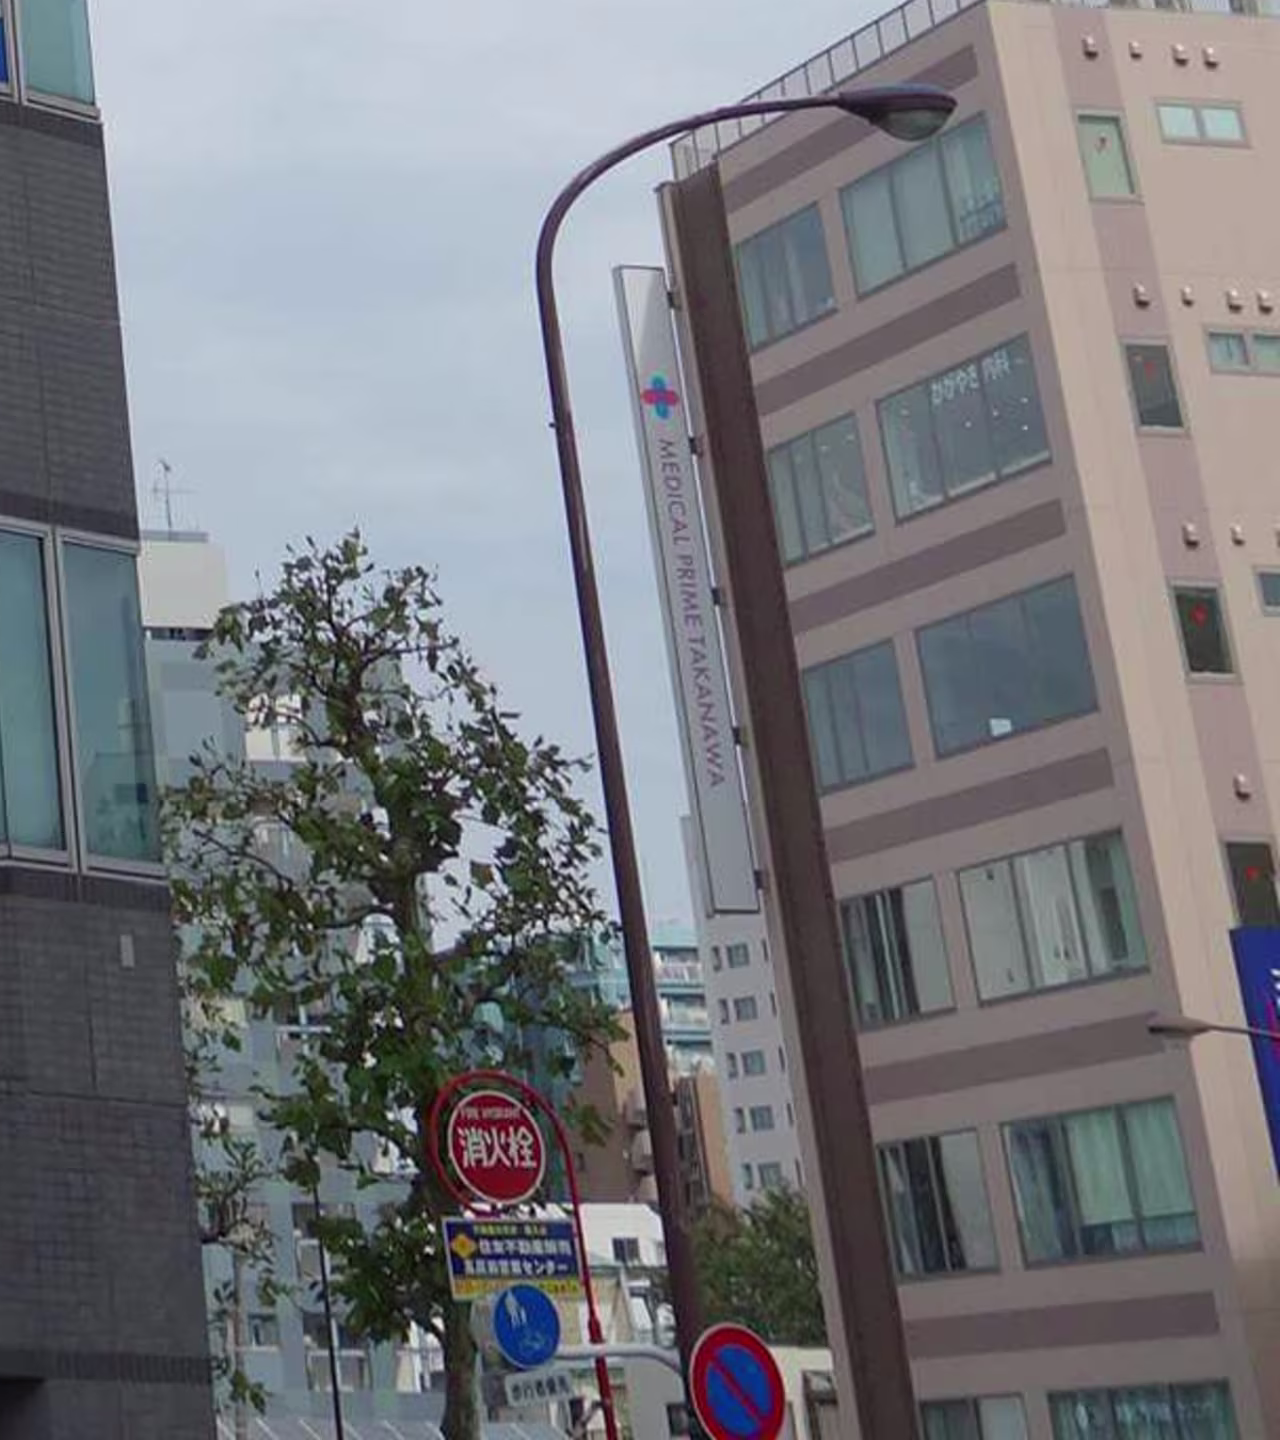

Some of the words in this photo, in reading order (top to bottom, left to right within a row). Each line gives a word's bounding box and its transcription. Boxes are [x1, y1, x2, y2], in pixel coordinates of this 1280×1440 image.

[658, 438, 690, 545] MEDICAL
[677, 553, 702, 629] PRIME
[688, 637, 725, 787] TAKANAWA
[457, 1126, 537, 1169] 消火栓
